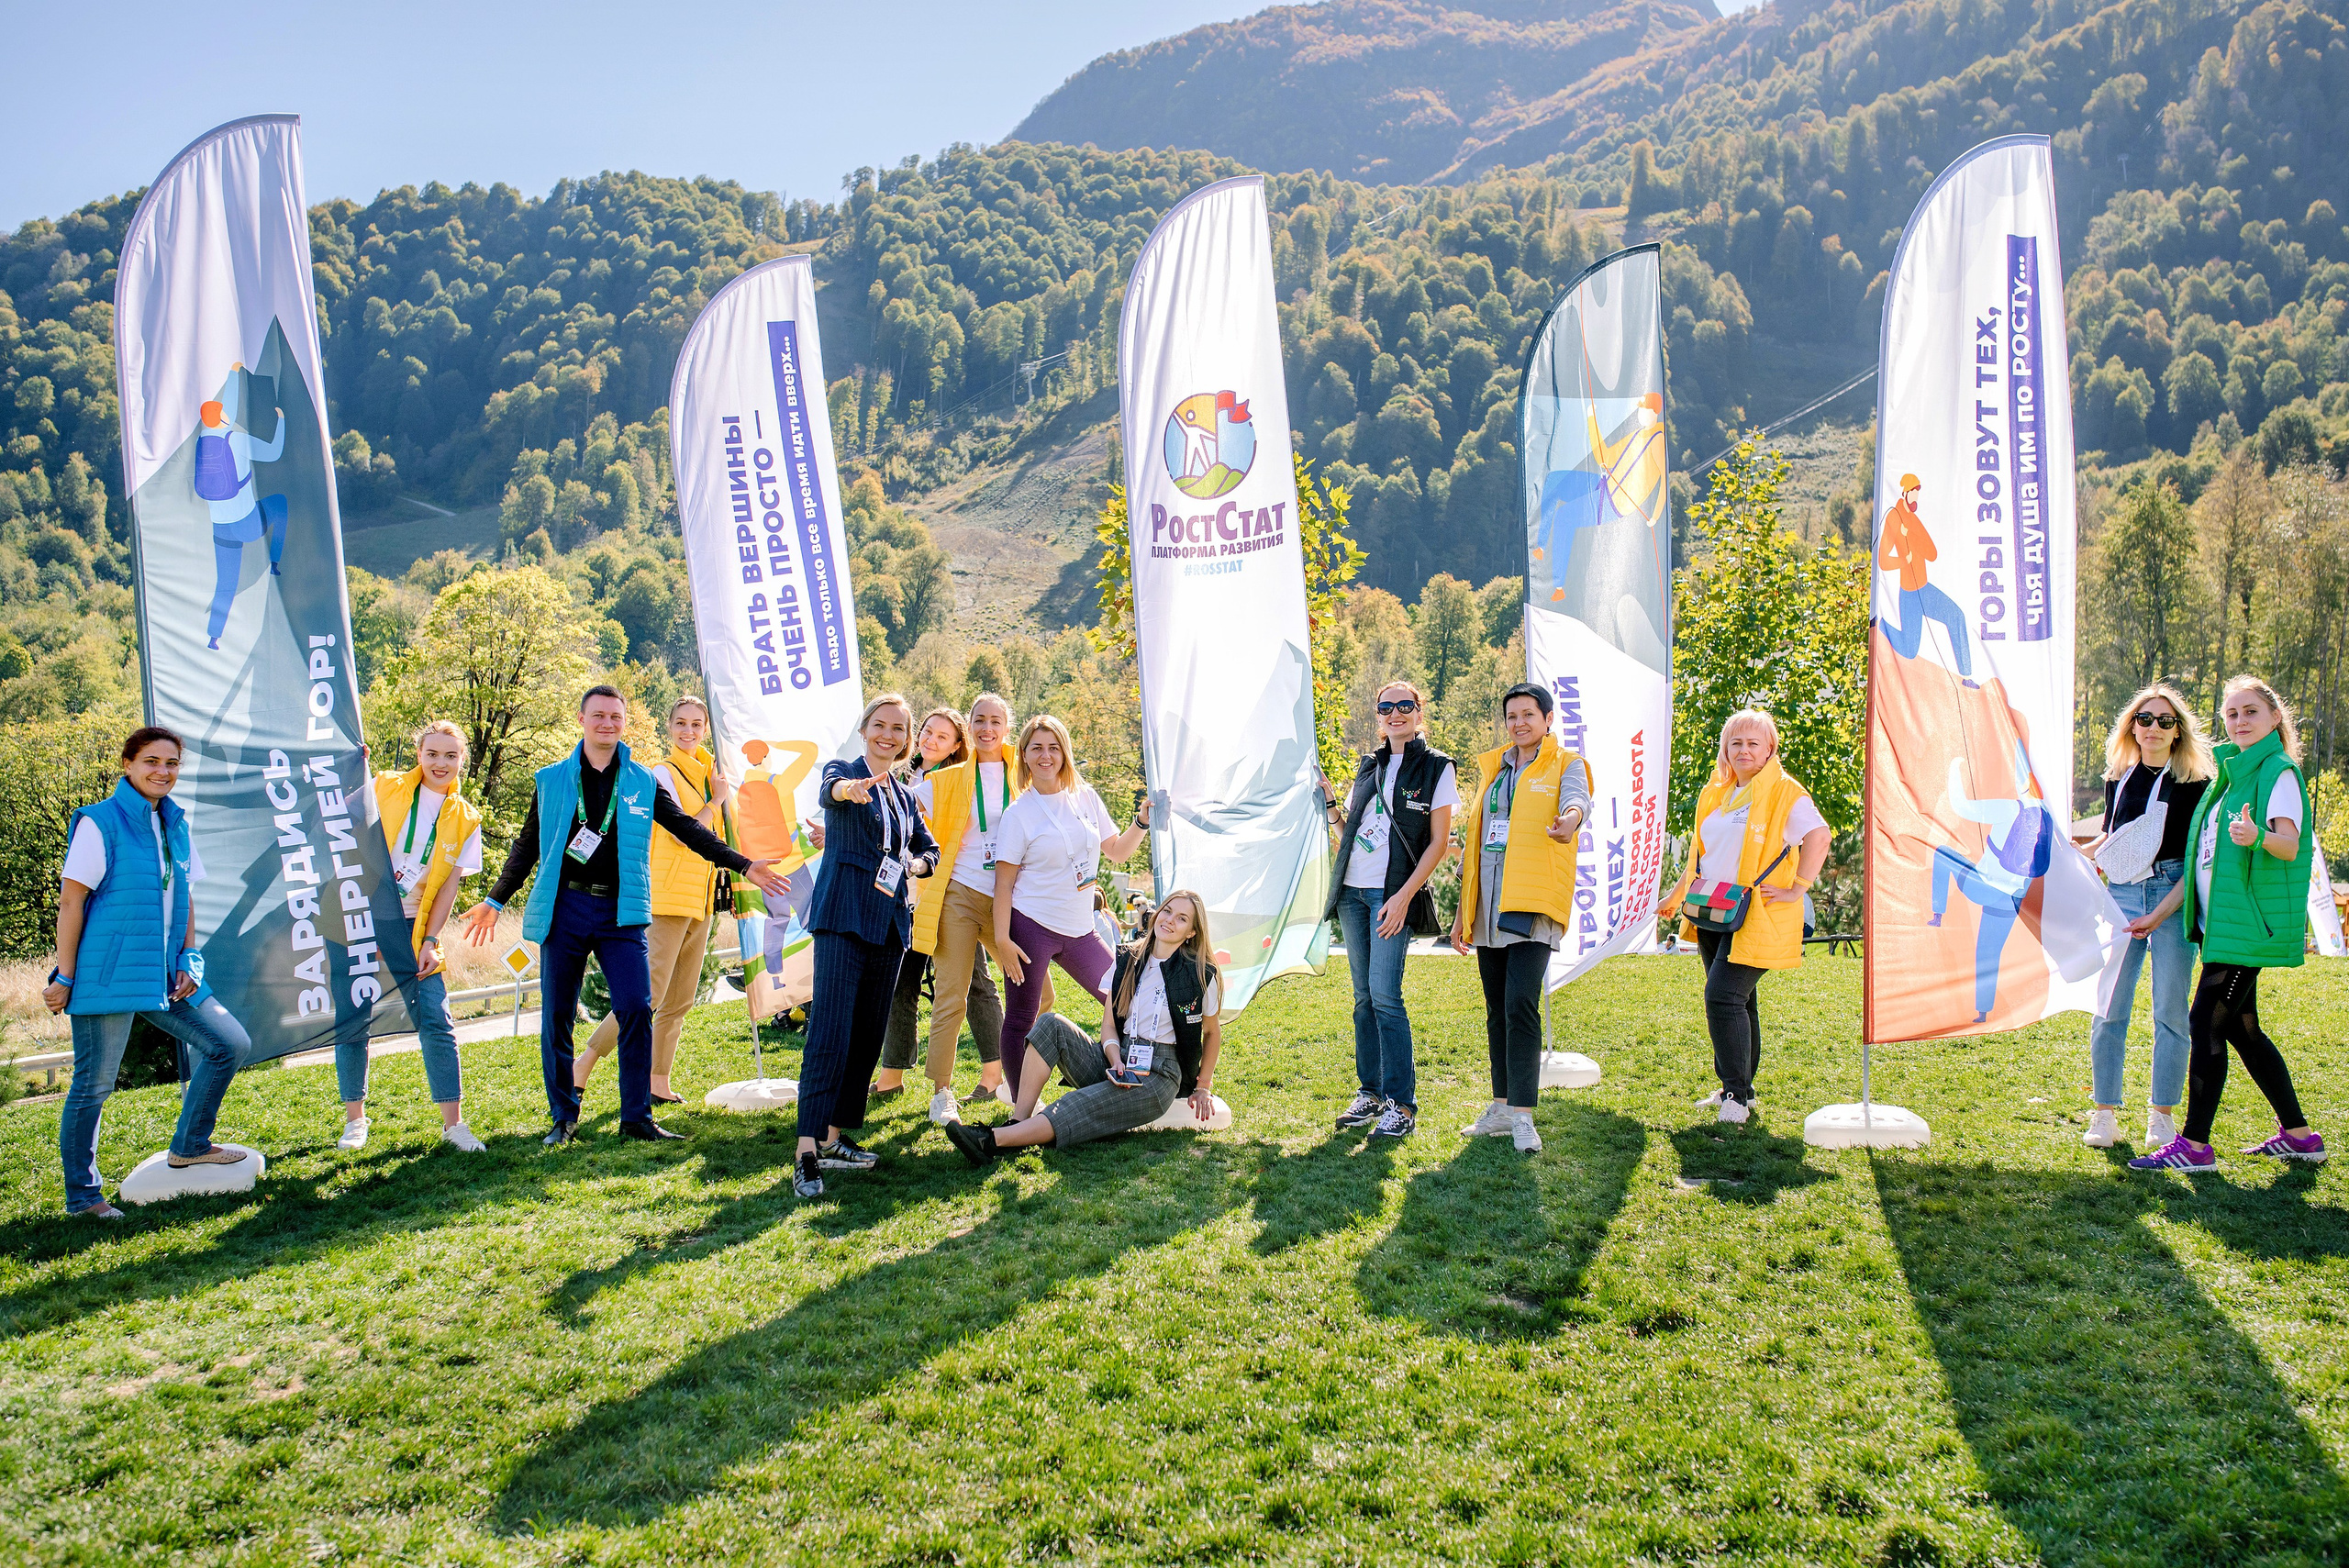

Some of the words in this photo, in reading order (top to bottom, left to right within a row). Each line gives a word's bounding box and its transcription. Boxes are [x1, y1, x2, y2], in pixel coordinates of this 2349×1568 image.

[1976, 306, 2002, 389] ТЕХ,
[788, 411, 806, 458] идти
[2015, 385, 2034, 422] по
[796, 462, 818, 519] время
[1976, 400, 2002, 523] ЗОВУТ
[2019, 431, 2038, 473] им
[722, 415, 764, 584] ВЕРШИНЫ
[753, 448, 793, 576] ПРОСТО
[807, 523, 824, 554] все
[2019, 481, 2045, 564] душа
[1151, 545, 1217, 559] ПЛАТФОРМА
[1220, 532, 1284, 556] РАЗВИТИЯ
[1184, 560, 1243, 576] #ROSSTAT
[813, 558, 834, 623] только
[1978, 536, 2006, 640] ГОРЫ
[2025, 573, 2045, 626] чья
[747, 593, 783, 695] БРАТЬ
[775, 584, 812, 690] ОЧЕНЬ
[823, 626, 842, 672] надо
[306, 634, 337, 741] ГОР!
[1631, 729, 1644, 824] РАБОТА
[1628, 828, 1642, 891] ТВОЯ
[1641, 795, 1657, 875] СОБОЙ
[262, 749, 330, 1018] ЗАРЯДИСЬ
[303, 755, 382, 1008] ЭНЕРГИЕЙ
